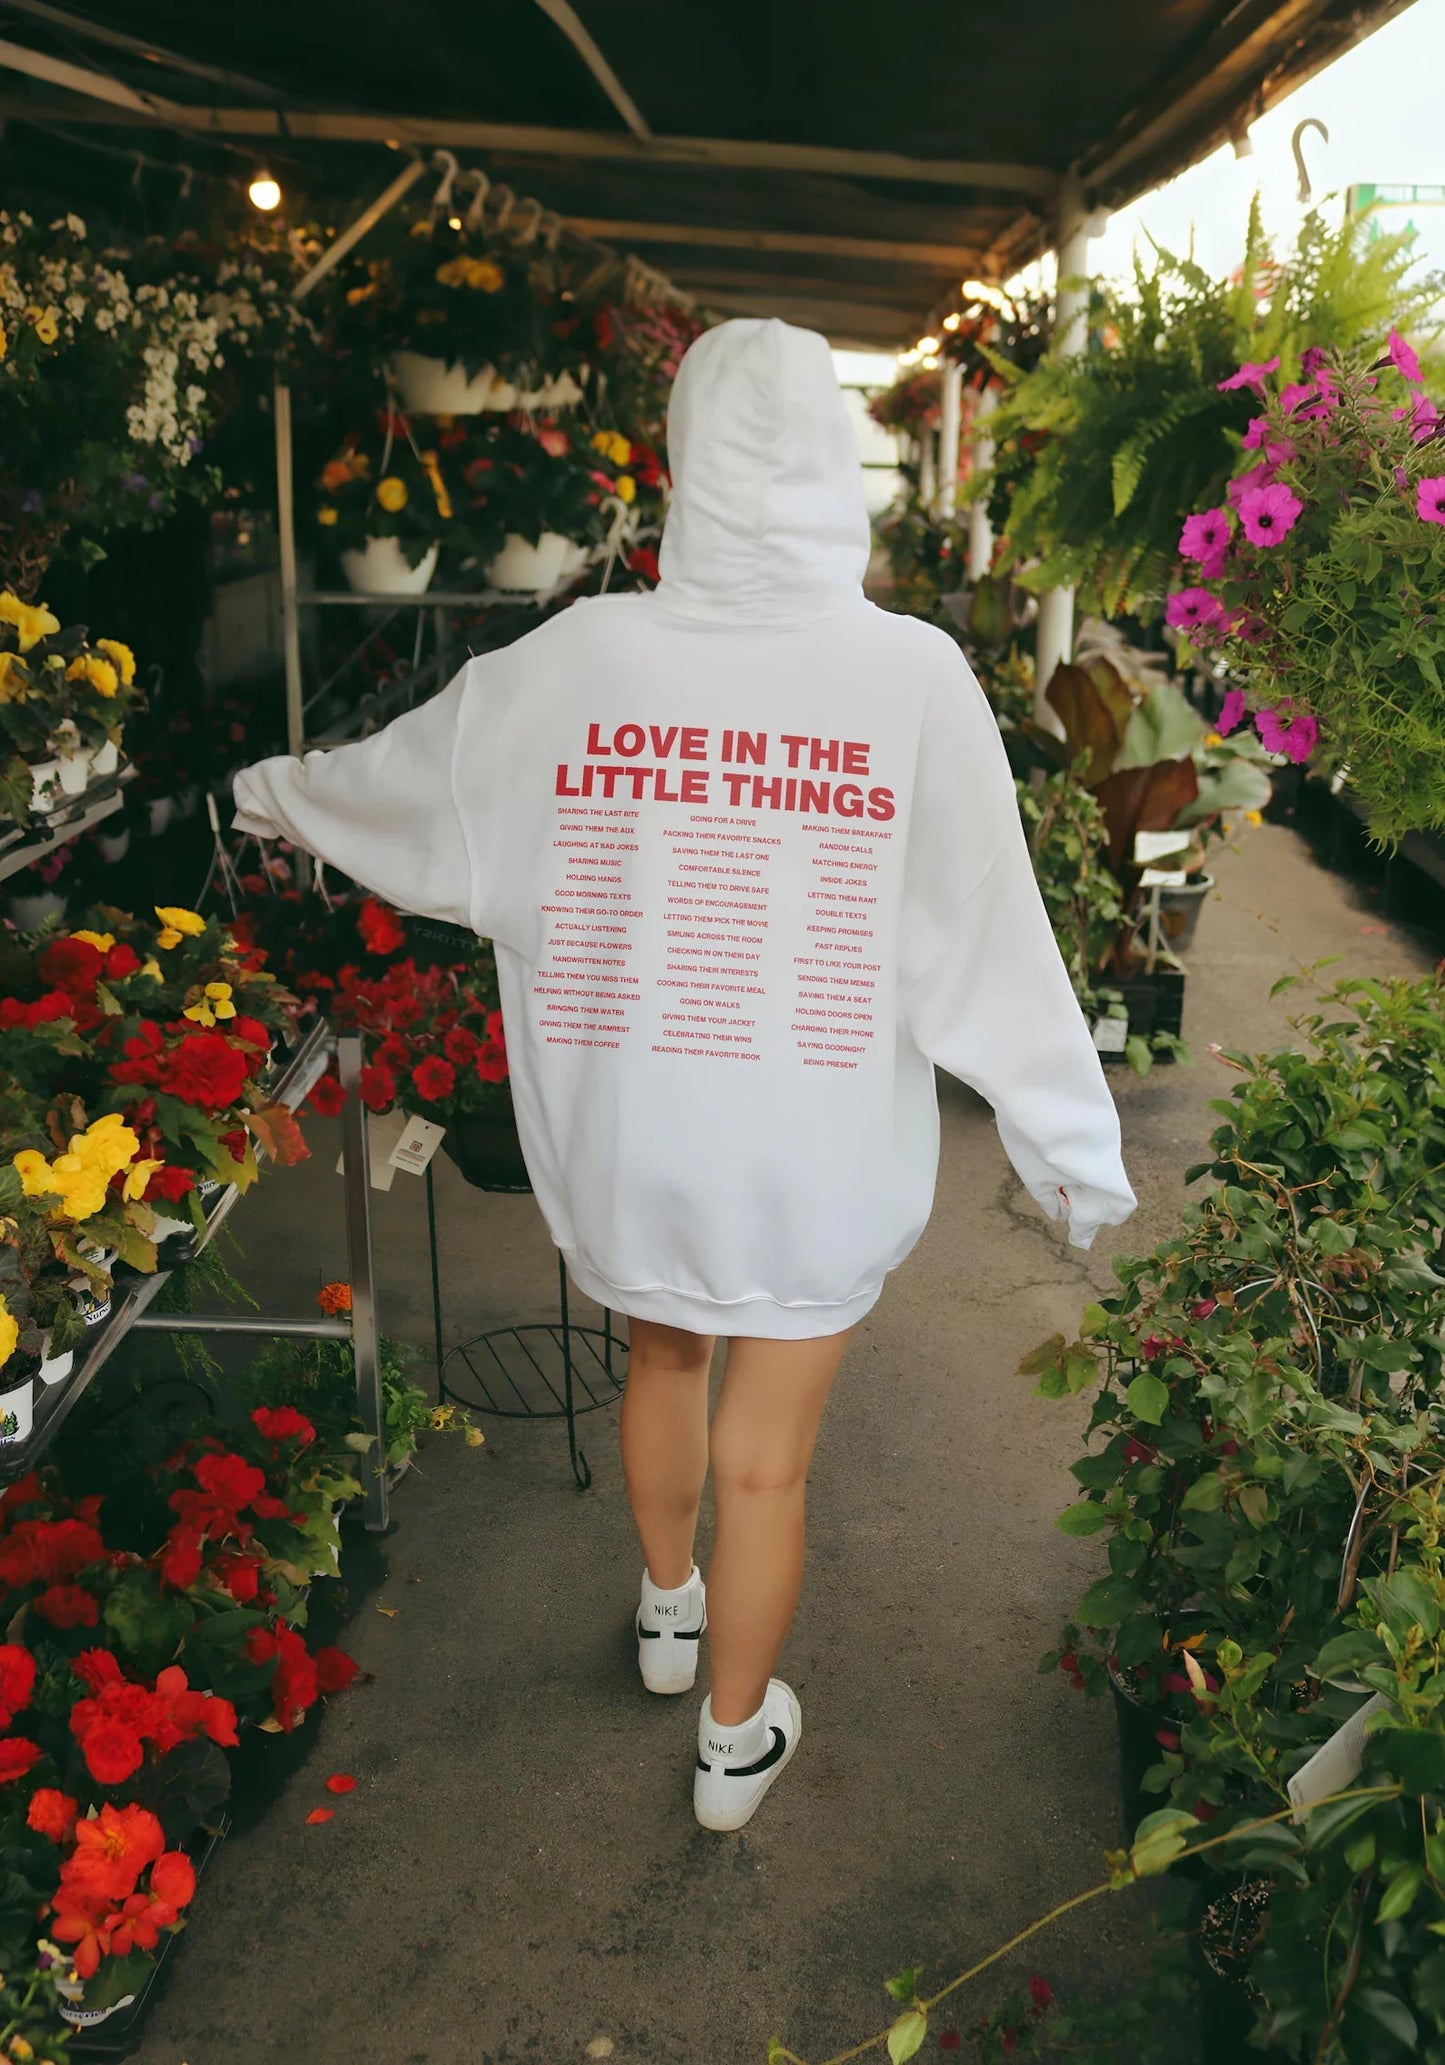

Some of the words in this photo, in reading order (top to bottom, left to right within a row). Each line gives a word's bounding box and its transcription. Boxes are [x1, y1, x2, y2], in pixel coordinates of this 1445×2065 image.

[586, 723, 709, 760] LOVE
[720, 729, 768, 765] IN
[780, 734, 871, 775] THE
[555, 764, 710, 803] LITTLE
[722, 772, 896, 822] THINGS
[690, 815, 713, 823] GOING
[736, 819, 757, 827] DRIVE
[663, 830, 694, 838] PACKING
[696, 832, 716, 840] THEIR
[717, 834, 751, 842] FAVORITE
[752, 837, 781, 845] SNACKS
[802, 824, 830, 833] MAKING
[831, 827, 850, 835] THEM
[851, 829, 892, 839] BREAKFAST
[672, 847, 699, 855] SAVING
[721, 850, 734, 858] THE
[755, 853, 770, 861] ONE
[819, 843, 850, 851] RANDOM
[850, 846, 873, 854] CALLS
[568, 857, 599, 865] SHARING
[600, 859, 622, 867] MUSIC
[812, 859, 849, 868] MATCHING
[850, 862, 878, 871] ENERGY
[678, 864, 731, 874] COMFORTABLE
[731, 868, 761, 877] SILENCE
[668, 880, 696, 888] TELLING
[697, 882, 717, 890] THEM
[729, 885, 750, 893] DRIVE
[820, 876, 843, 884] INSIDE
[844, 878, 868, 887] JOKES
[576, 891, 608, 899] MORNING
[807, 892, 837, 900] LETTING
[837, 894, 858, 902] THEM
[858, 896, 877, 904] RANT
[667, 897, 693, 905] WORDS
[705, 900, 767, 910] ENCOURAGEMENT
[541, 905, 574, 913] KNOWING
[619, 910, 644, 918] ORDER
[815, 909, 844, 918] DOUBLE
[845, 912, 867, 920] TEXTS
[663, 913, 692, 921] LETTING
[693, 915, 713, 923] THEM
[731, 918, 746, 926] THE
[746, 920, 769, 928] MOVIE
[555, 923, 590, 931] ACTUALLY
[591, 925, 627, 933] LISTENING
[806, 925, 837, 934] KEEPING
[838, 928, 873, 937] PROMISES
[667, 930, 695, 938] SMILING
[696, 933, 726, 941] ACROSS
[741, 936, 763, 944] ROOM
[566, 940, 598, 948] BECAUSE
[599, 942, 633, 950] FLOWERS
[815, 942, 833, 950] FAST
[834, 944, 863, 953] REPLIES
[667, 947, 703, 955] CHECKING
[724, 951, 744, 959] THEIR
[552, 956, 602, 965] HANDWRITTEN
[793, 957, 814, 965] FIRST
[825, 960, 841, 968] LIKE
[842, 962, 862, 970] YOUR
[666, 963, 698, 972] SHARING
[720, 968, 759, 977] INTERESTS
[538, 971, 565, 979] TELLING
[601, 975, 619, 983] MISS
[797, 975, 828, 983] SENDING
[829, 977, 849, 985] THEM
[850, 979, 875, 988] MEMES
[656, 979, 689, 988] COOKING
[711, 984, 745, 992] FAVORITE
[746, 986, 766, 994] MEAL
[534, 987, 562, 995] HELPING
[563, 989, 594, 997] WITHOUT
[595, 991, 616, 999] BEING
[617, 993, 641, 1001] ASKED
[798, 991, 825, 999] SAVING
[679, 998, 702, 1006] GOING
[715, 1001, 740, 1009] WALKS
[547, 1004, 579, 1012] BRINGING
[600, 1008, 625, 1016] WATER
[795, 1008, 826, 1016] HOLDING
[827, 1011, 853, 1019] DOORS
[853, 1013, 873, 1021] OPEN
[661, 1013, 686, 1021] GIVING
[728, 1019, 756, 1027] JACKET
[597, 1025, 630, 1033] ARMREST
[663, 1030, 711, 1039] CELEBRATING
[791, 1024, 828, 1033] CHARGING
[829, 1027, 849, 1035] THEIR
[850, 1029, 874, 1038] PHONE
[546, 1037, 573, 1045] MAKING
[593, 1041, 620, 1049] COFFEE
[797, 1041, 824, 1049] SAYING
[824, 1044, 866, 1053] GOODNIGHT
[651, 1045, 683, 1054] READING
[705, 1050, 740, 1059] FAVORITE
[740, 1053, 761, 1061] BOOK
[803, 1058, 825, 1066] BEING
[826, 1060, 858, 1069] PRESENT
[654, 1604, 678, 1616] NIKE
[708, 1739, 734, 1754] NIKE
